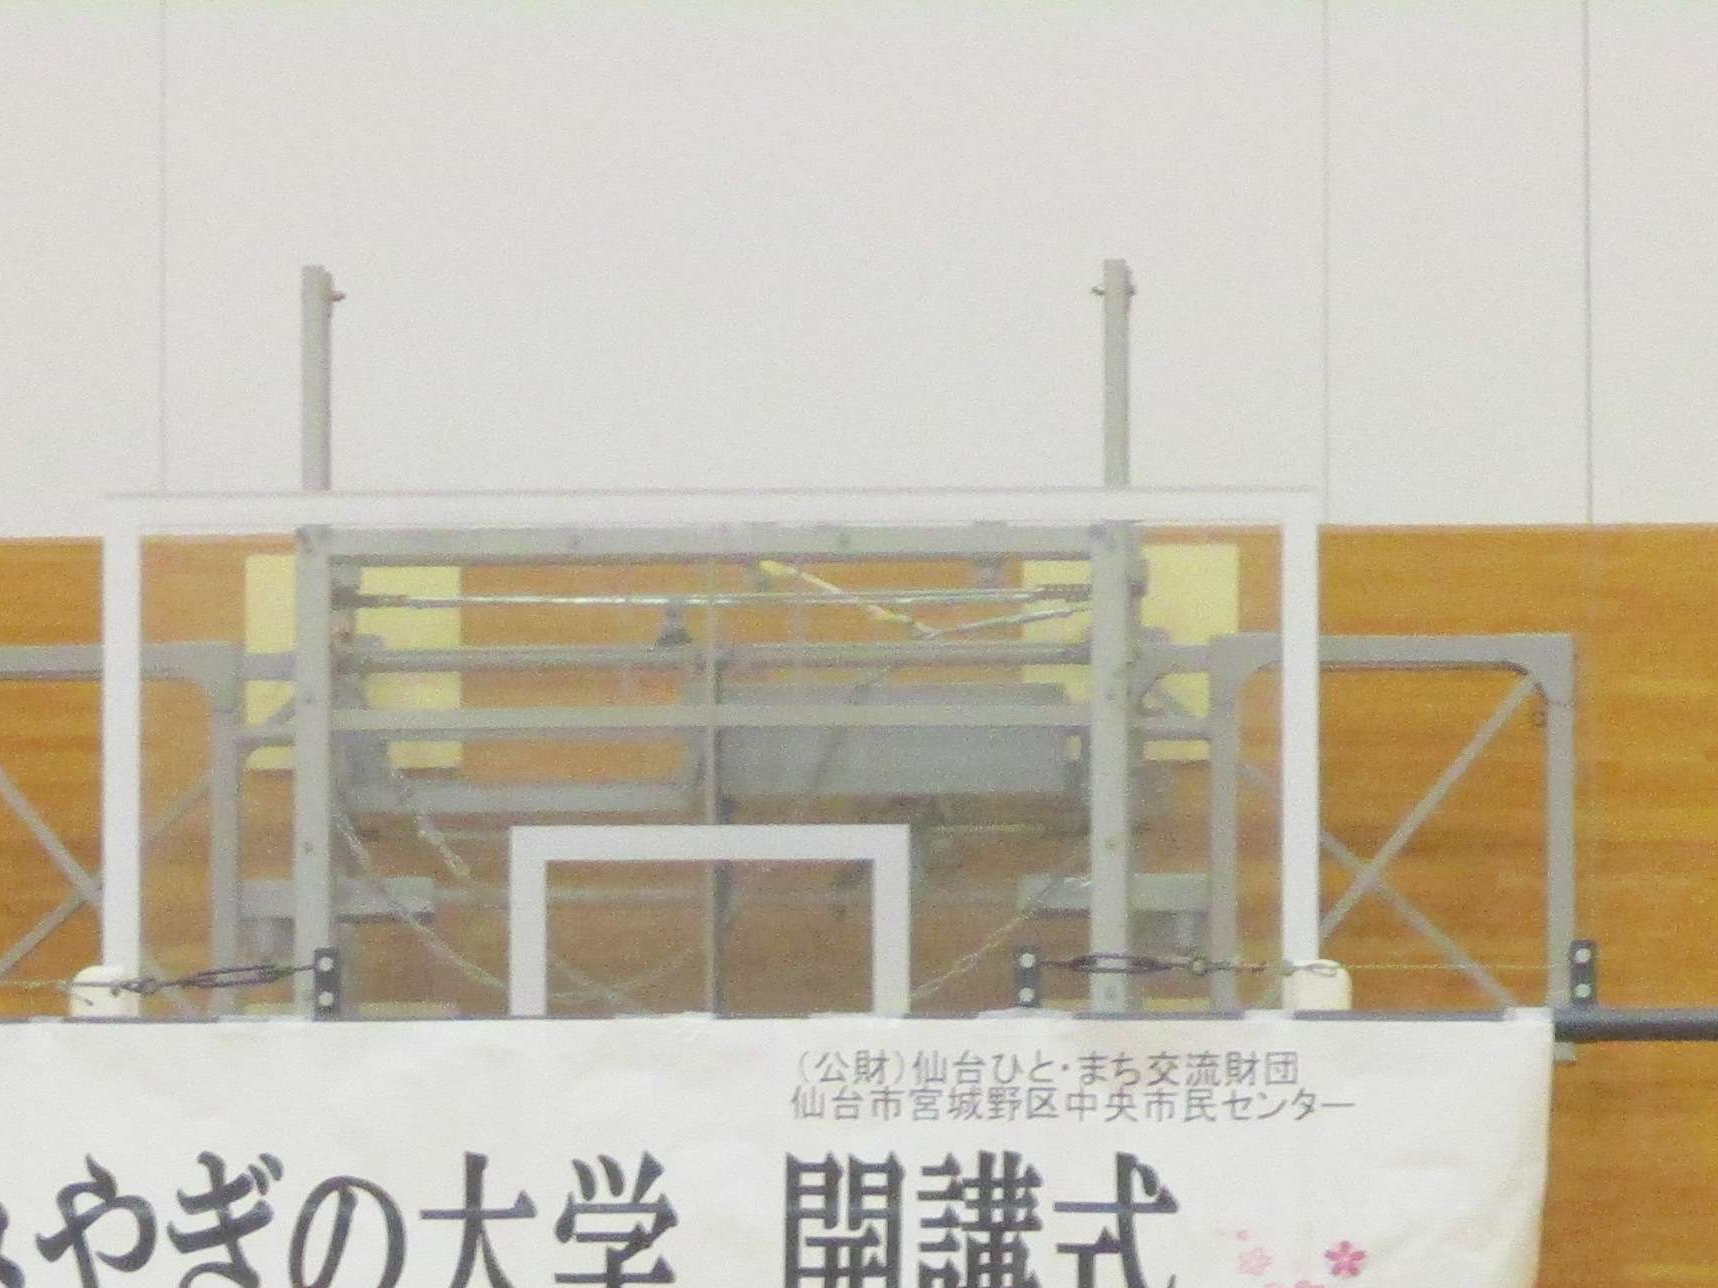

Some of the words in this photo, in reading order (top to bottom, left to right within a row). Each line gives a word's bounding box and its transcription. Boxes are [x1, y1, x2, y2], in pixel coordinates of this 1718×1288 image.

[790, 1086, 1356, 1122] 仙台市宮城野区中央市民センター
